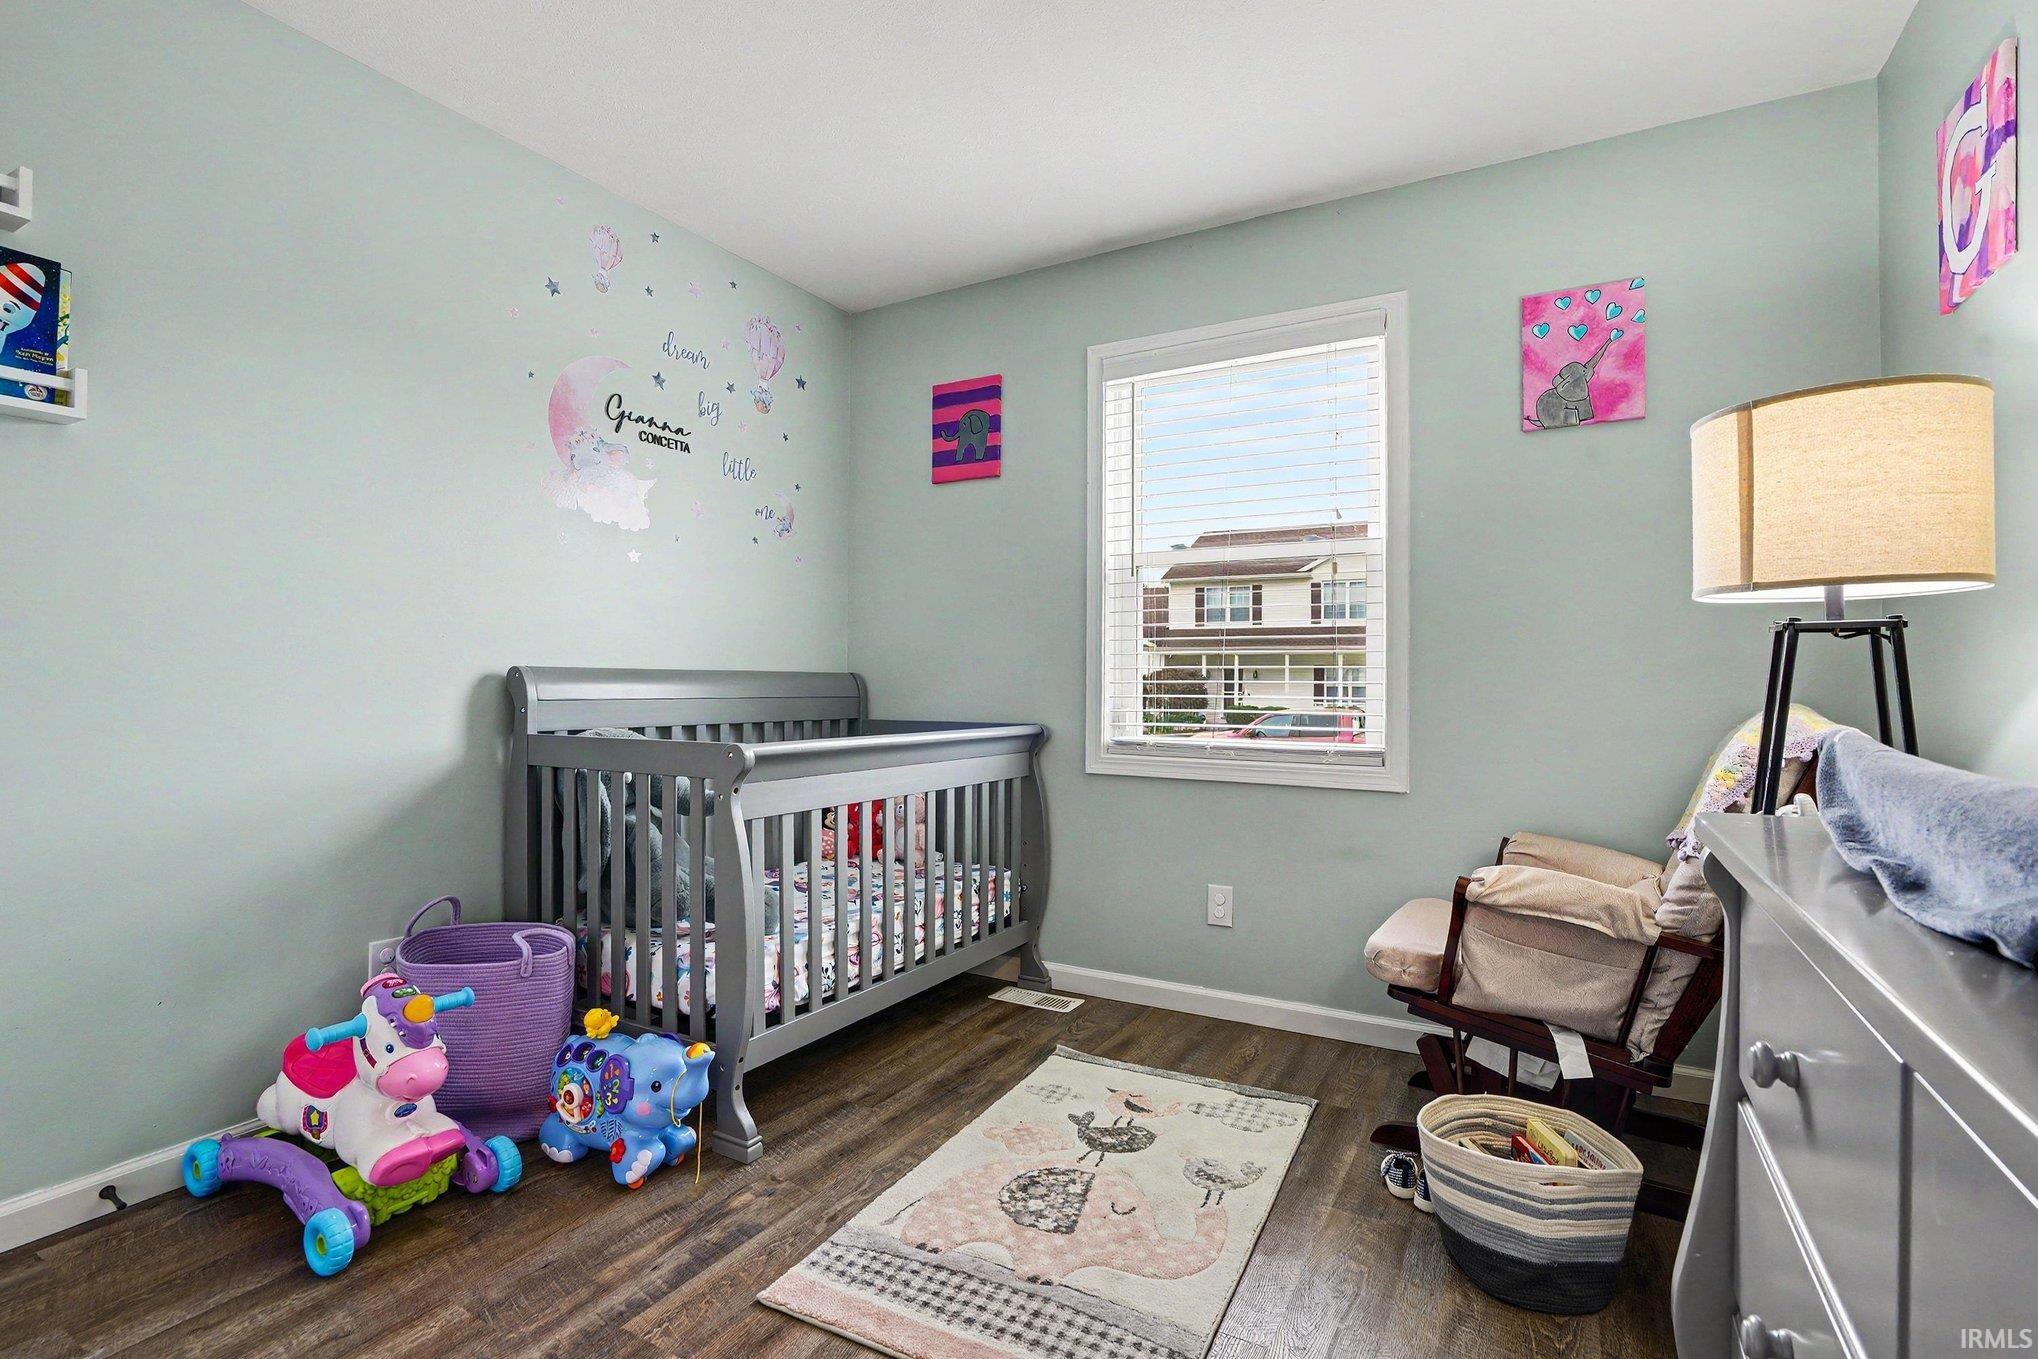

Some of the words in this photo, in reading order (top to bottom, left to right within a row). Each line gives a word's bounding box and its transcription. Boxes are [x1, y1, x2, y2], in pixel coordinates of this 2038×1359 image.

[662, 331, 711, 370] dream
[606, 393, 692, 437] Gianna
[697, 390, 723, 427] big
[638, 430, 691, 454] CONCETTA
[722, 451, 757, 482] little
[754, 505, 776, 520] one
[604, 1092, 613, 1106] 3
[612, 1079, 620, 1094] 2
